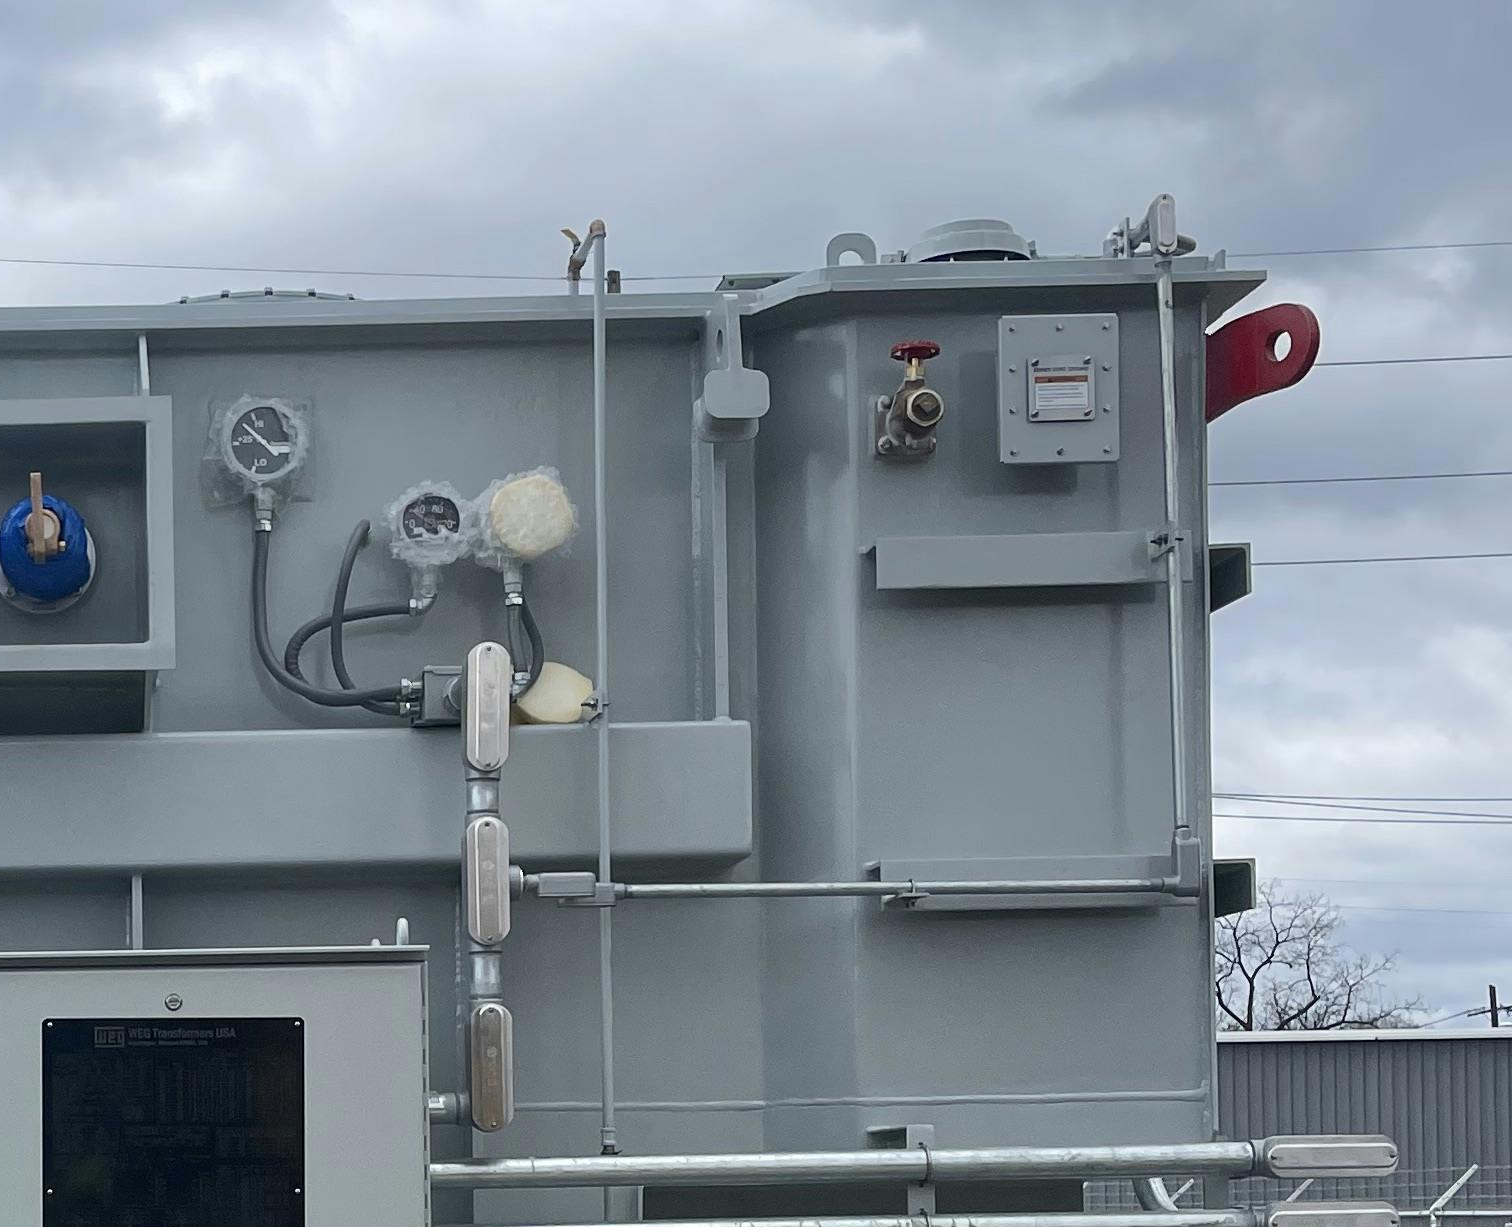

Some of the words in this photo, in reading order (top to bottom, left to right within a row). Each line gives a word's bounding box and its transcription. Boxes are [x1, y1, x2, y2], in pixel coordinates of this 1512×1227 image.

[254, 458, 268, 467] LO
[128, 1028, 151, 1039] WEG
[152, 1028, 214, 1039] Transformers
[215, 1027, 237, 1038] USA
